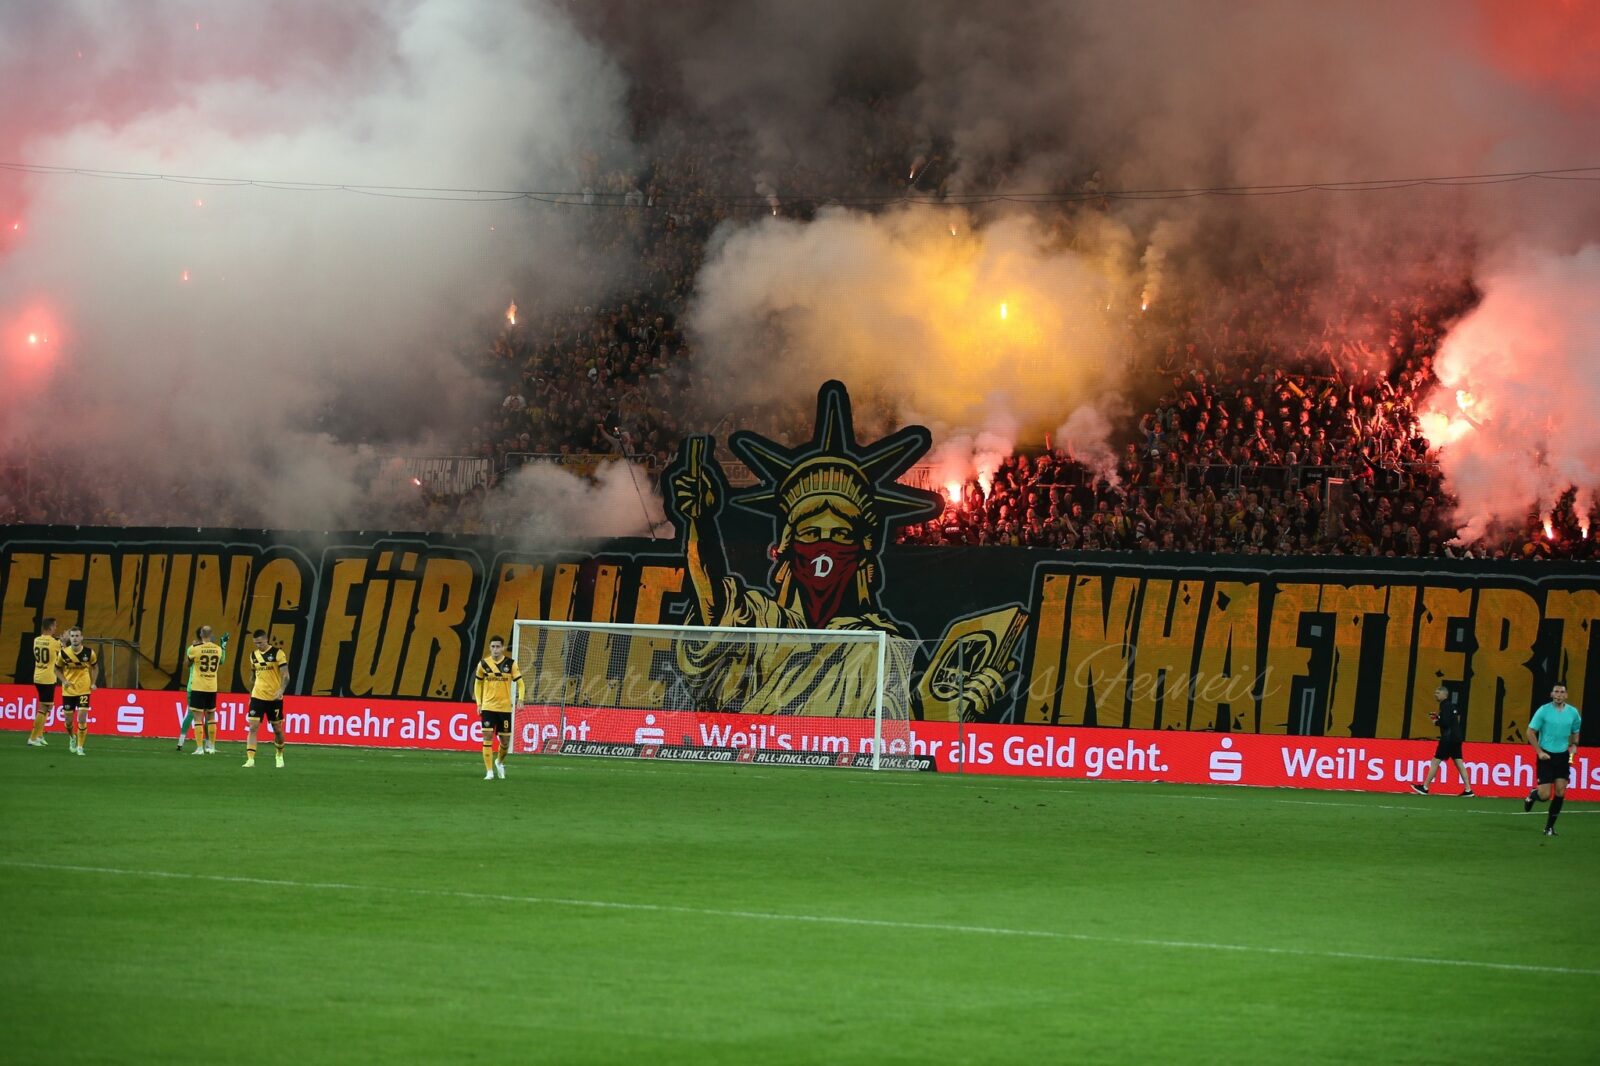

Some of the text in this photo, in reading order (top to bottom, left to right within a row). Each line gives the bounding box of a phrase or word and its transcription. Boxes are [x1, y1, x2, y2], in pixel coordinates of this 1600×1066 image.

[811, 554, 833, 577] D
[34, 647, 50, 664] 30
[313, 551, 473, 698] FÜR
[480, 563, 685, 706] ALLE
[1025, 574, 1600, 744] INHAFTIERT
[200, 655, 219, 673] 33
[0, 697, 37, 720] eld
[80, 695, 88, 704] 22
[274, 709, 280, 718] 7
[319, 708, 394, 737] mehr
[400, 711, 440, 740] als
[449, 713, 491, 742] Ge
[699, 723, 1168, 777] Weil's um mehr als Geld geht.
[855, 757, 930, 769] ALLINKL.COM
[1281, 747, 1384, 780] Weil's
[1395, 759, 1447, 784] um
[1458, 755, 1534, 787] meh
